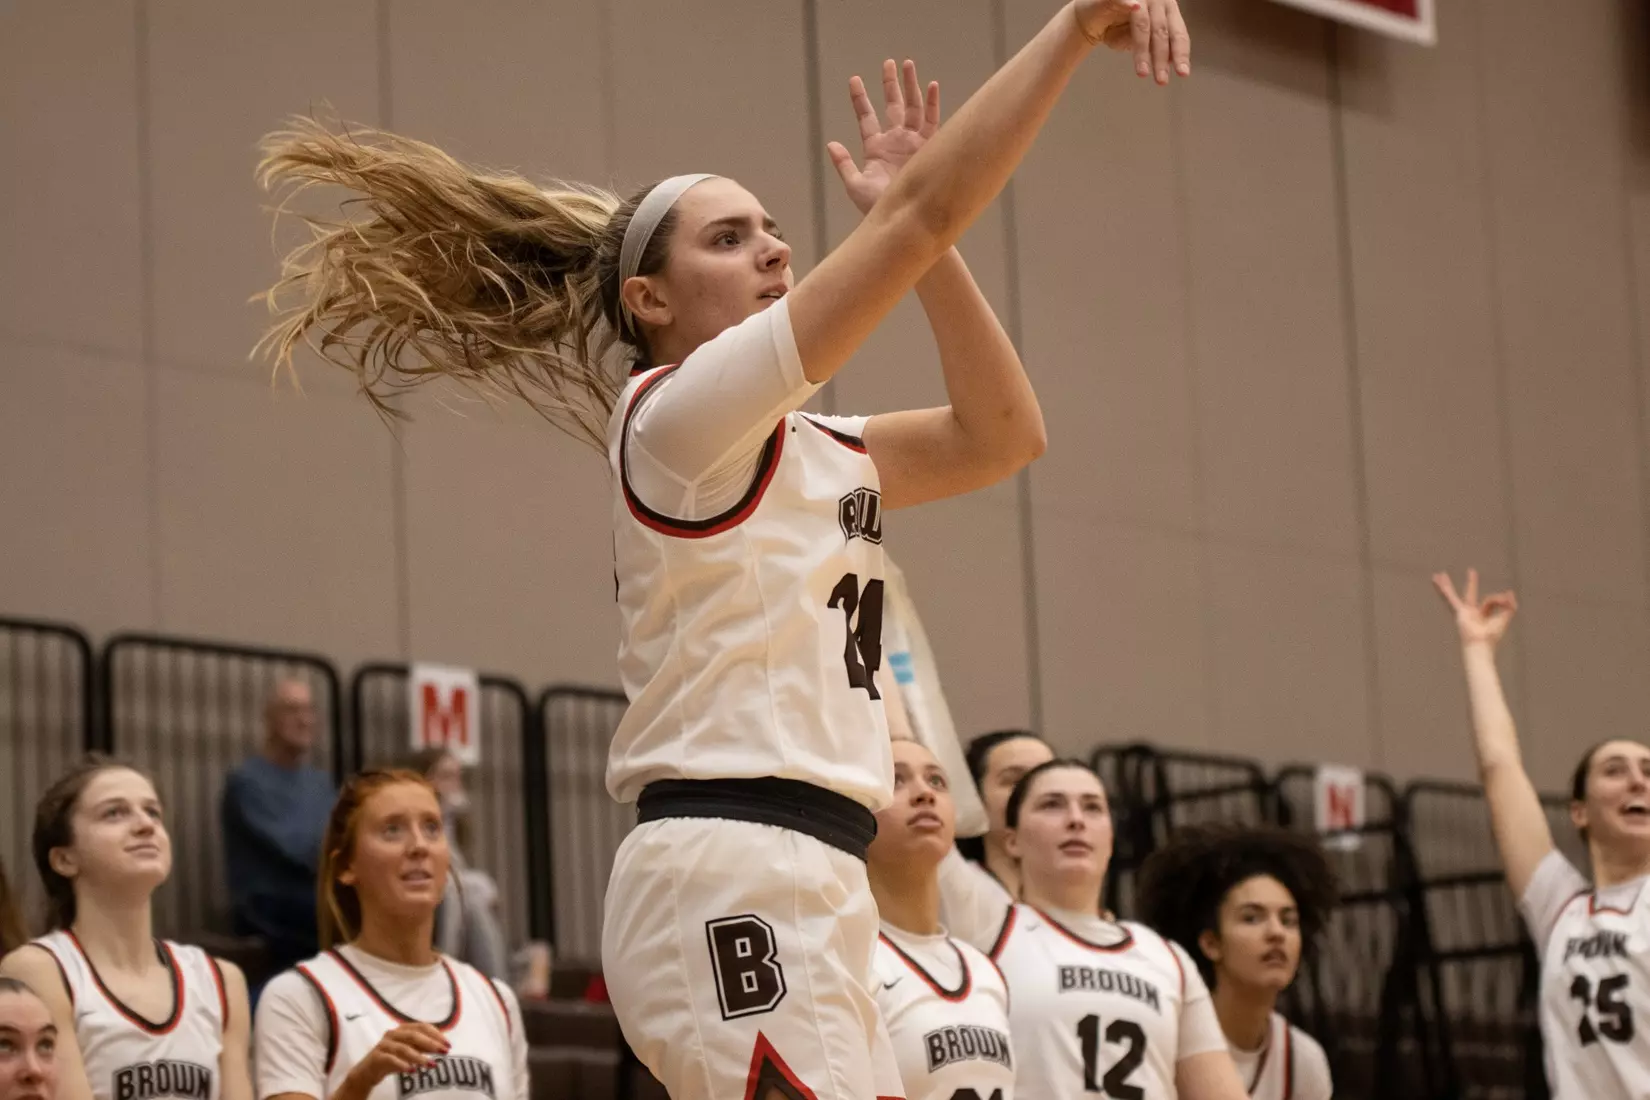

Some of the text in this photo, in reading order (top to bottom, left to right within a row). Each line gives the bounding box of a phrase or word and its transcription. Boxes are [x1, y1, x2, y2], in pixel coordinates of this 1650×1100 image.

[420, 683, 468, 746] M
[705, 914, 787, 1021] B
[1057, 965, 1162, 1016] BROWN
[922, 1025, 1013, 1074] BROWN
[1076, 1013, 1147, 1100] 12
[111, 1059, 213, 1100] BROWN
